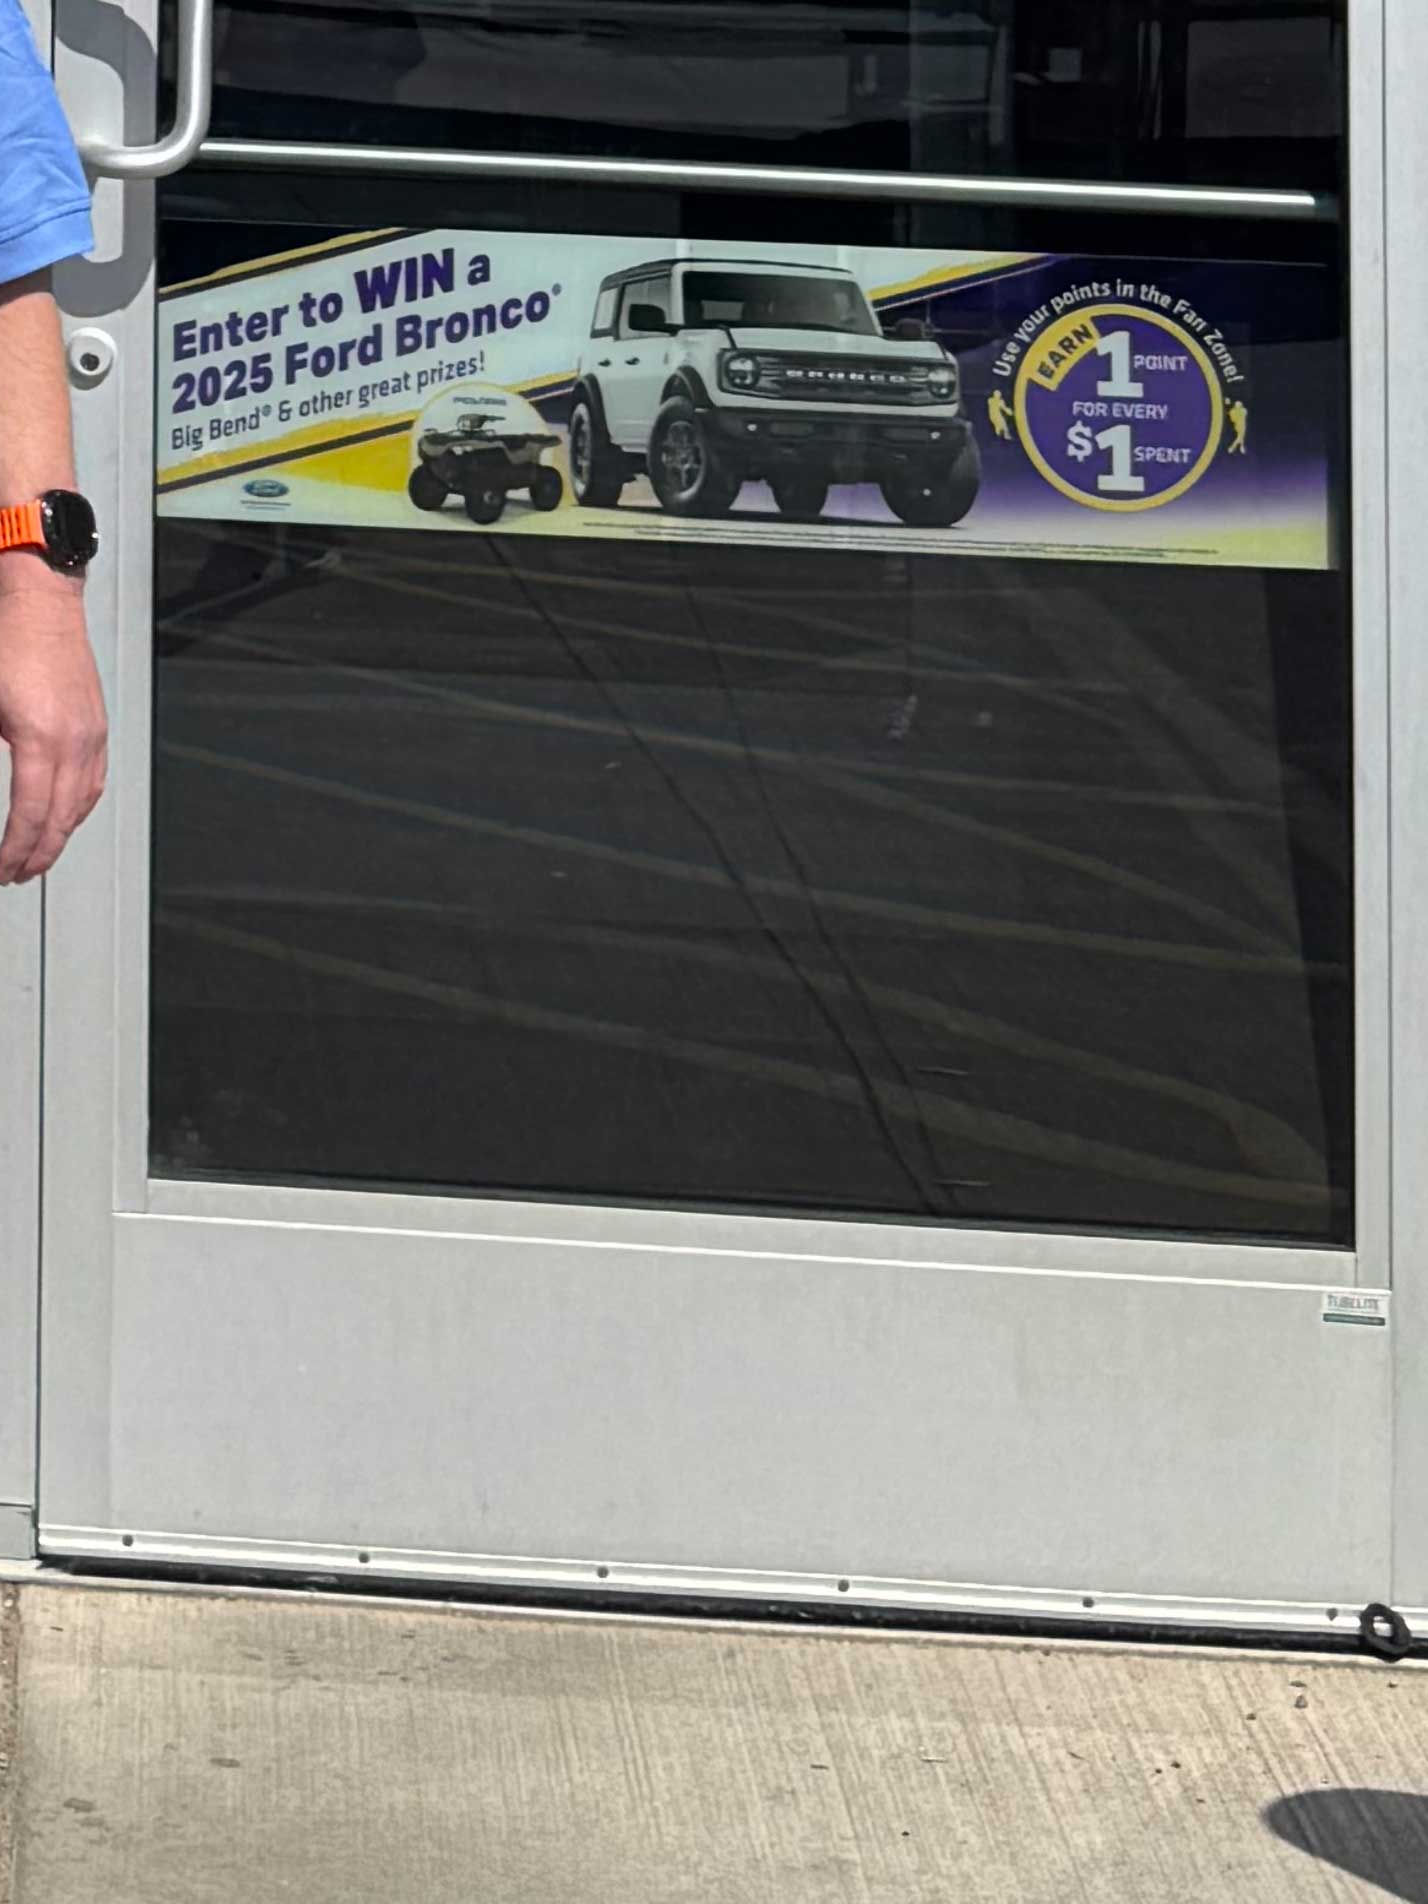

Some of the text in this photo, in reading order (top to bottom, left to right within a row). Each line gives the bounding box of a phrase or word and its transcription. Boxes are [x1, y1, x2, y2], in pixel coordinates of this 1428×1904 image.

[171, 247, 492, 362] Enter to WIN a
[992, 279, 1245, 384] Use your points in the Fan Zone!
[171, 352, 274, 415] 2025
[284, 323, 383, 386] Ford
[1037, 323, 1093, 380] EARN
[1095, 330, 1188, 398] 1 POINT
[171, 426, 203, 452] Big
[278, 399, 293, 422] &
[297, 386, 355, 418] other
[358, 372, 413, 410] great
[416, 349, 486, 393] prizes!
[1072, 401, 1168, 420] FOR EVERY
[1066, 420, 1192, 492] $1 SPENT
